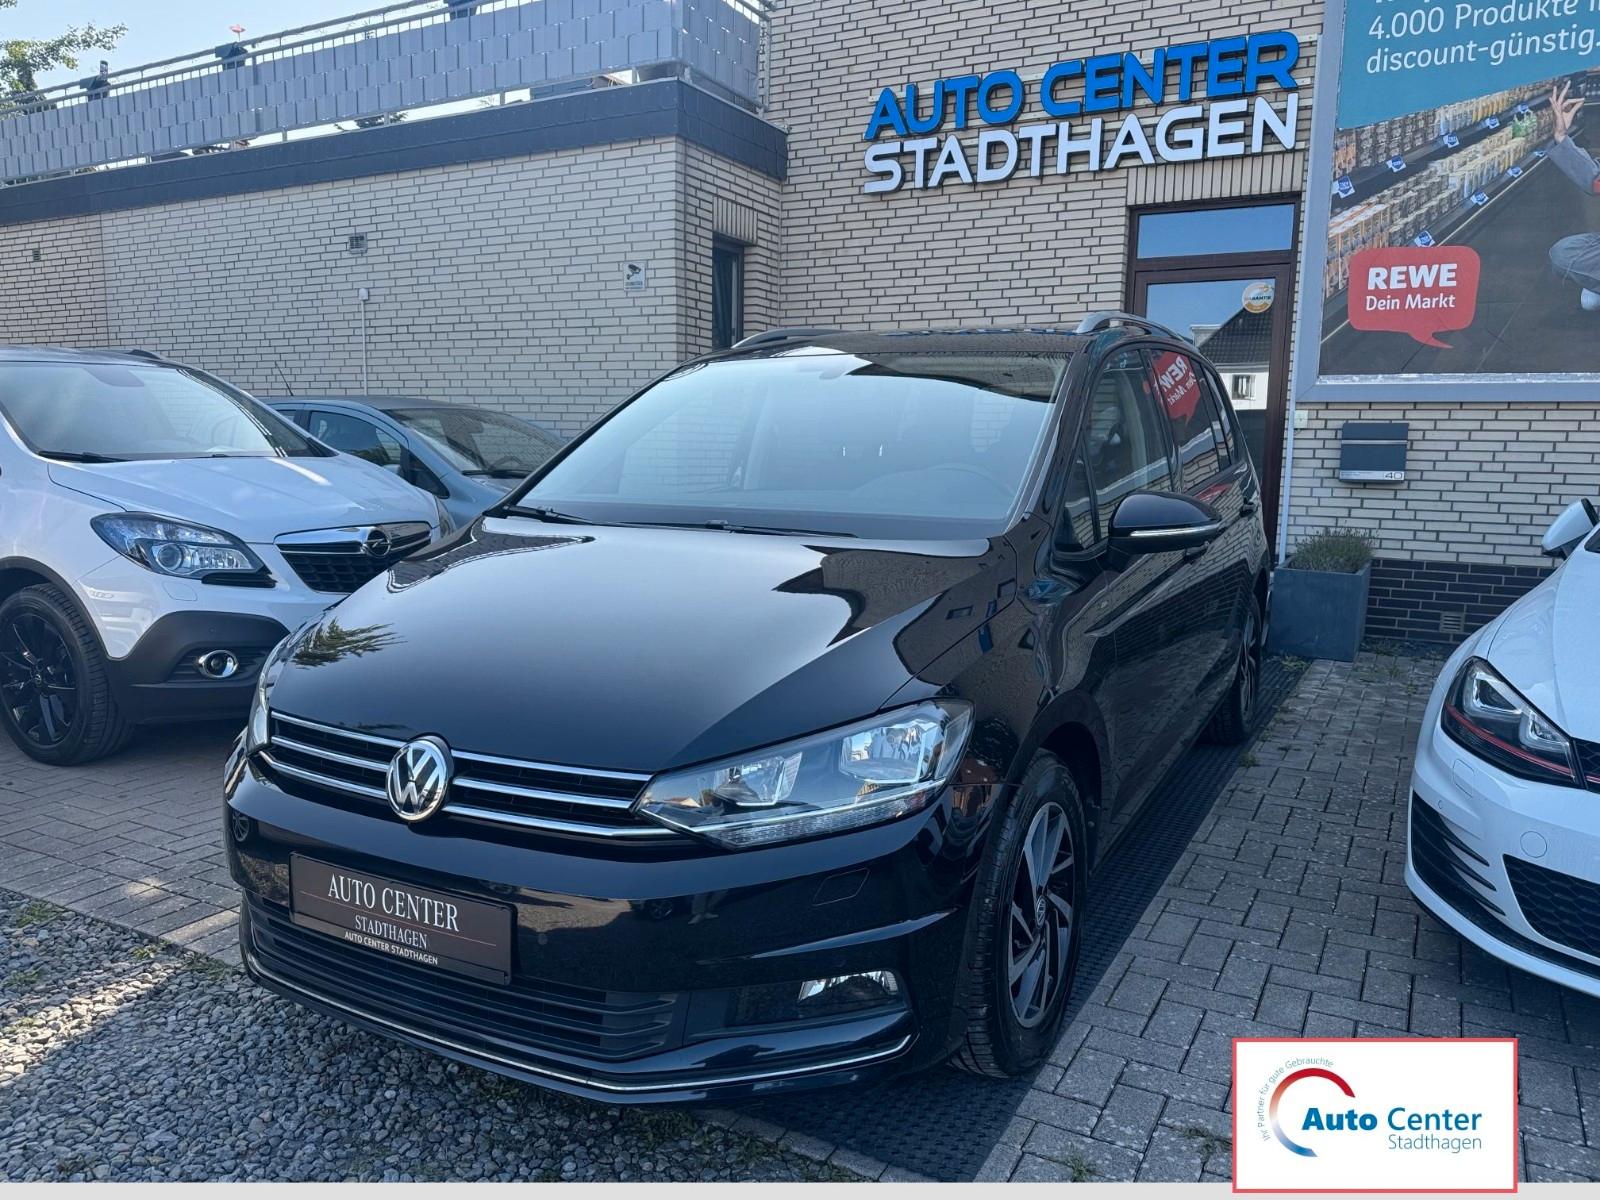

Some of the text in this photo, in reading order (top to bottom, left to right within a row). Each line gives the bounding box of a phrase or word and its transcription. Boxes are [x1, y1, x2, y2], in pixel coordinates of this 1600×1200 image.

[1369, 0, 1578, 40] 4.000 Produkte
[864, 31, 1301, 141] AUTO CENTER
[864, 93, 1299, 194] STADTHAGEN
[1367, 264, 1457, 290] REWE
[1366, 295, 1456, 311] Dein Markt
[328, 873, 459, 932] AUTO CENTER
[344, 931, 438, 965] AUTO CENTER STADTHAGEN
[355, 914, 428, 949] STADTHAGEN
